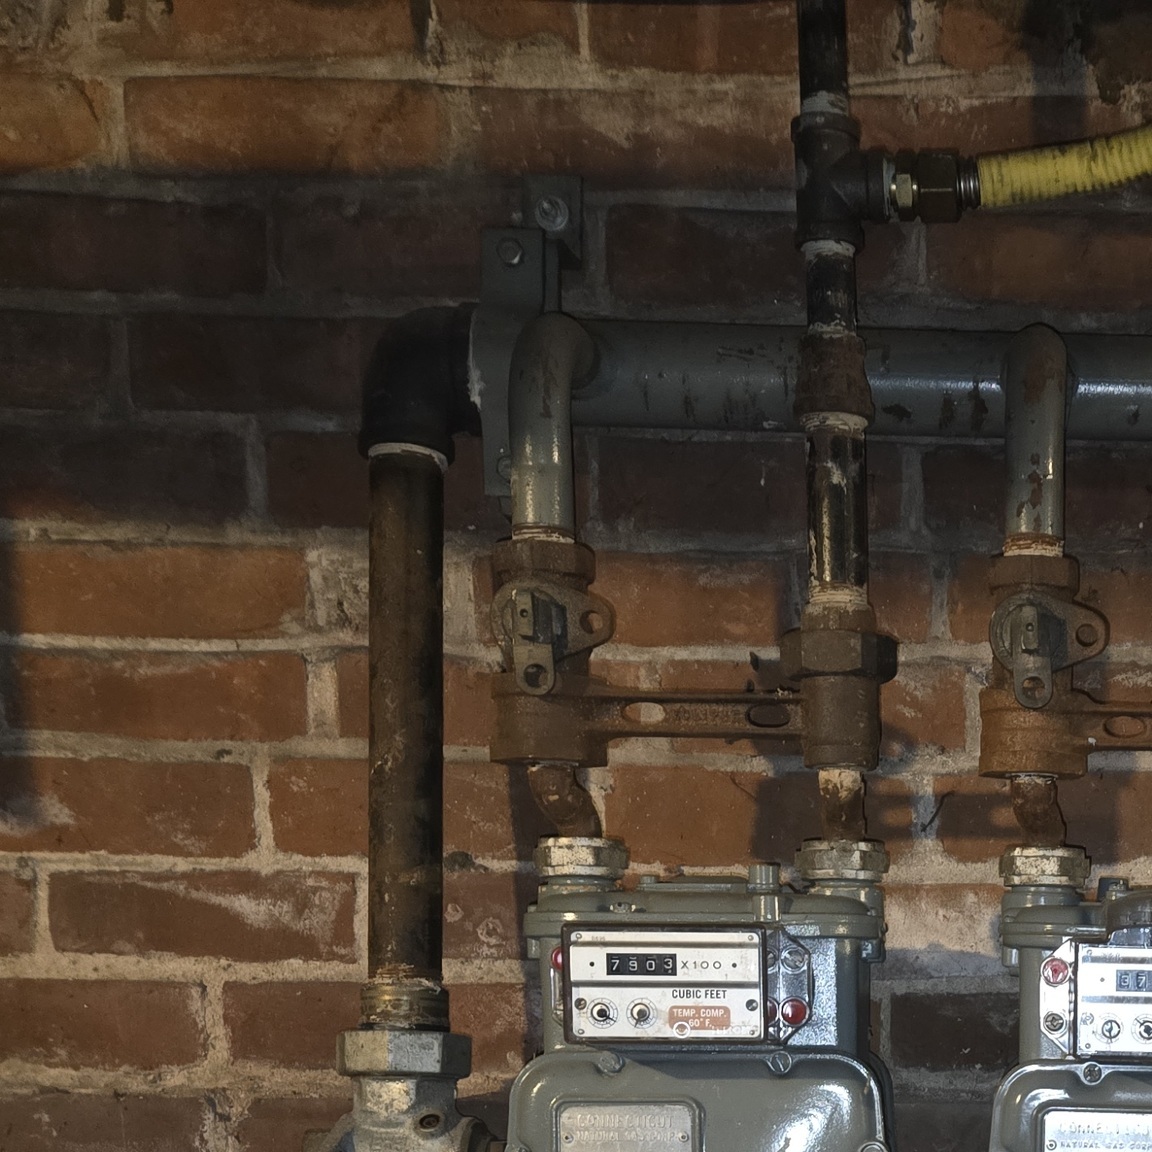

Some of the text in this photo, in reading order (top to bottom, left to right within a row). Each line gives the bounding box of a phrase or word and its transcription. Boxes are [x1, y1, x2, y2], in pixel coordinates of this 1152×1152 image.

[672, 989, 727, 999] CUBIC FEET
[673, 1009, 726, 1018] TEMP. COMP.
